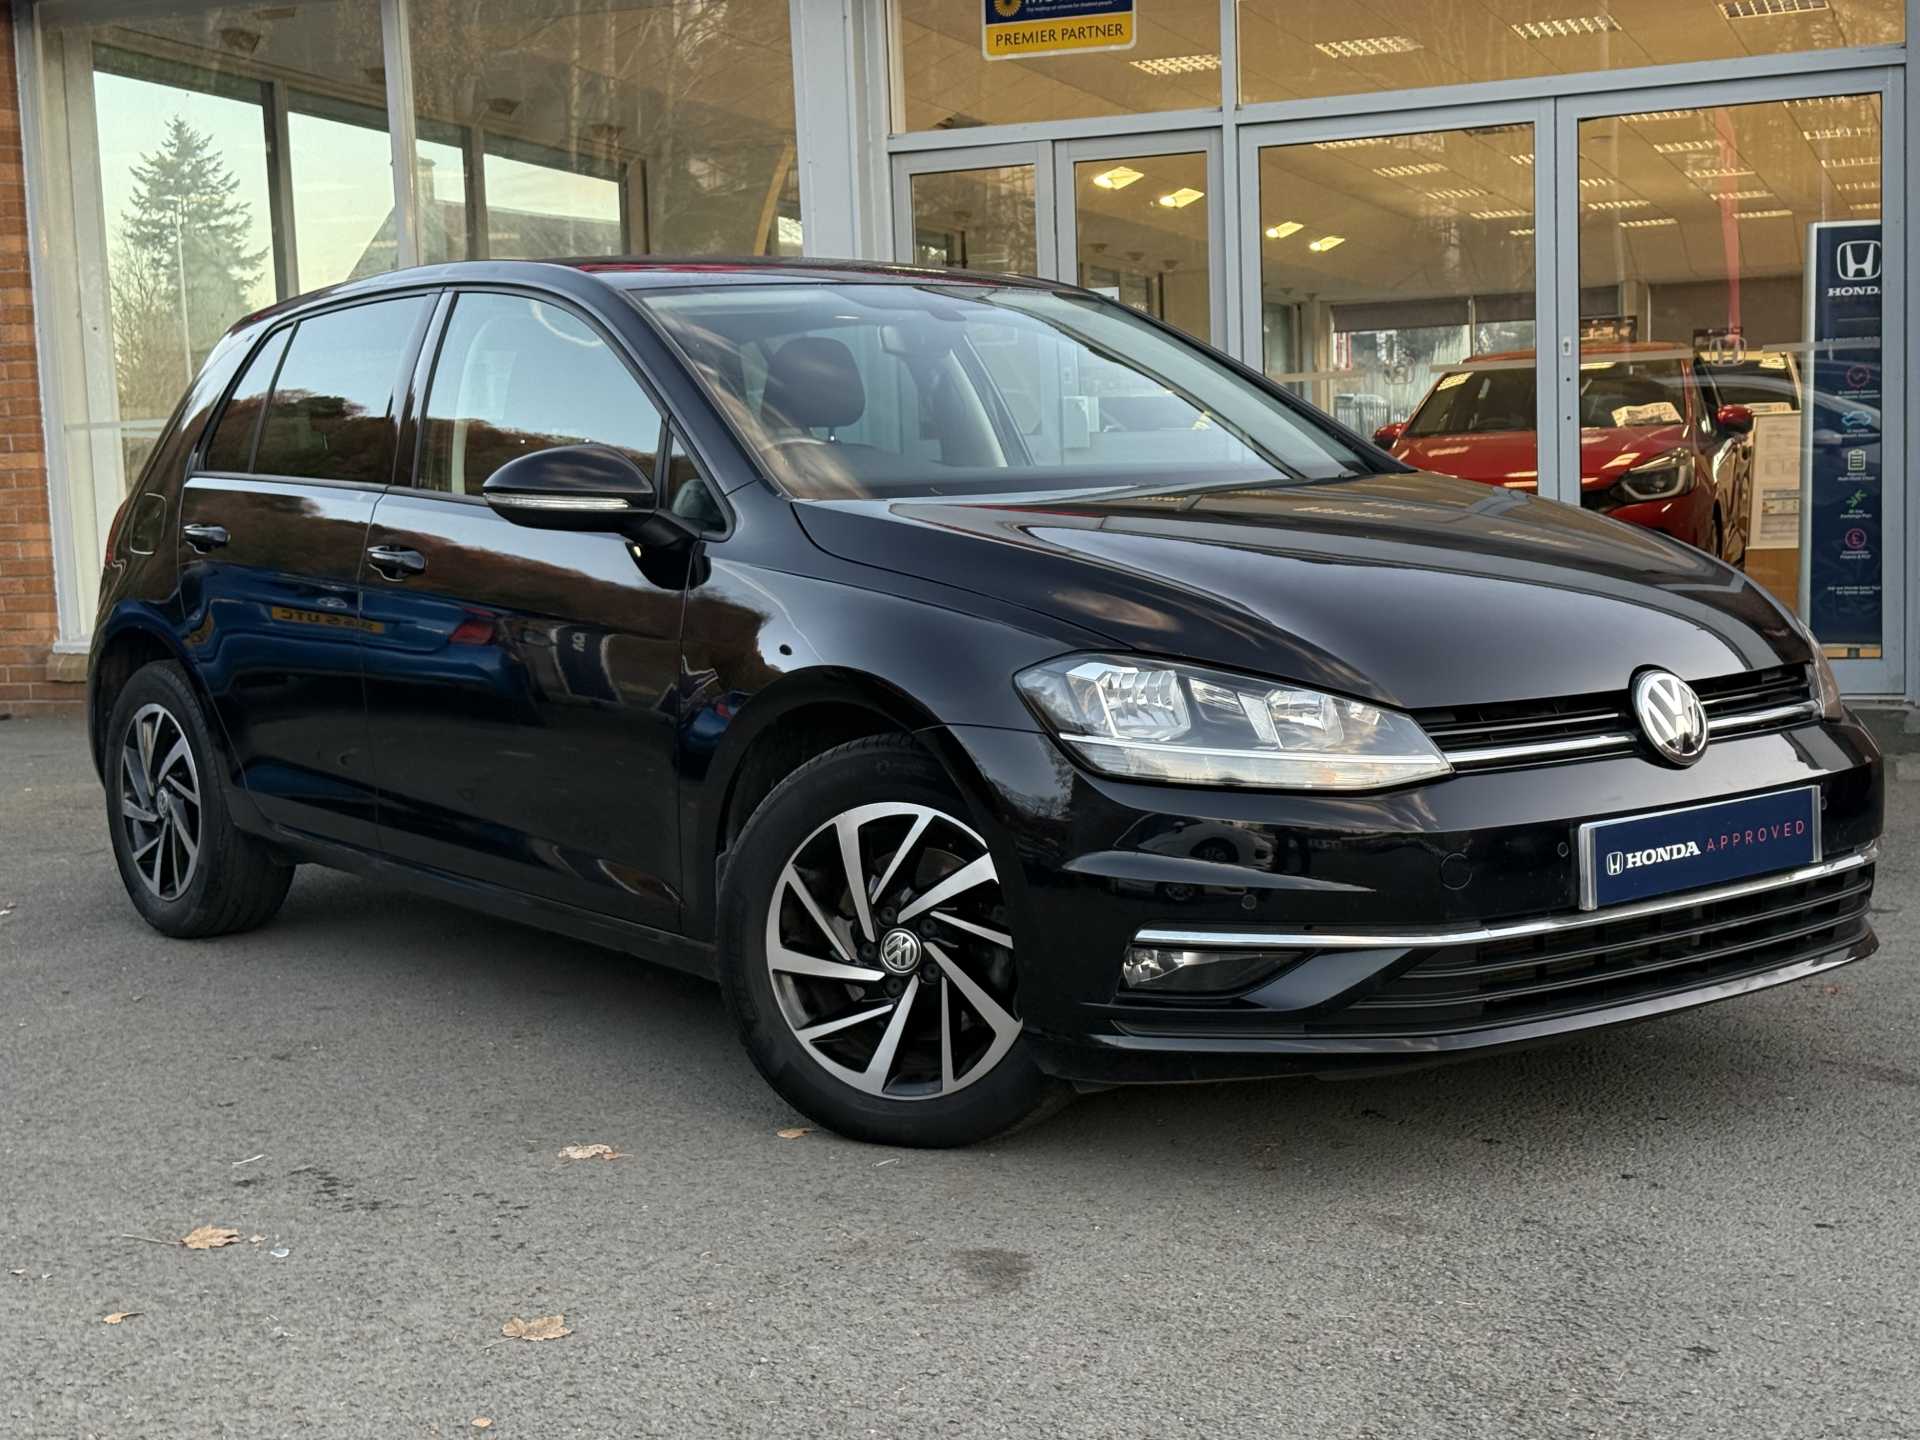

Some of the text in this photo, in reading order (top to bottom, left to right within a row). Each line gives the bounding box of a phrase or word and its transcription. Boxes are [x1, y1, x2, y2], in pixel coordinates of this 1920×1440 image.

[995, 23, 1124, 47] PREMIER PARTNER
[1827, 286, 1881, 297] HOND
[1626, 820, 1805, 869] HONDA APPROVED
